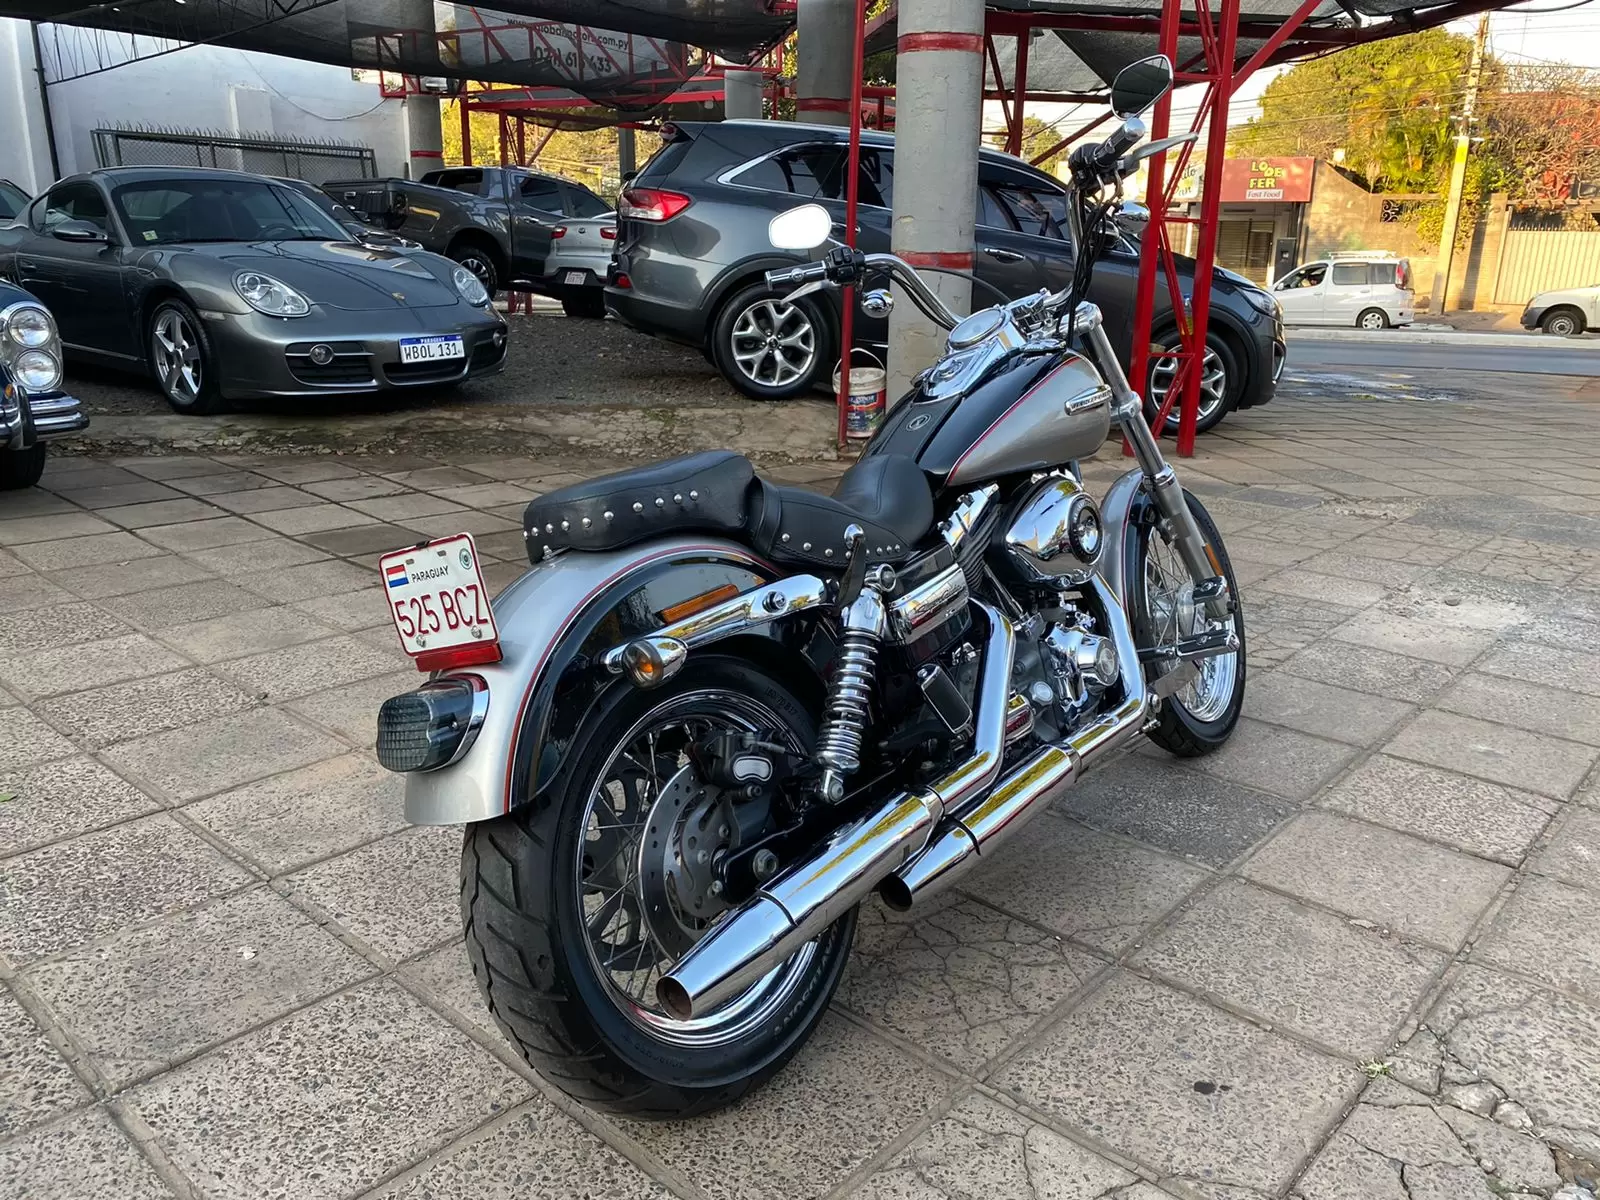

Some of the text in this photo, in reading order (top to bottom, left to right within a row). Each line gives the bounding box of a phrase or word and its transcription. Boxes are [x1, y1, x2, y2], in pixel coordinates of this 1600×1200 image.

[1249, 178, 1276, 188] FER
[404, 342, 458, 360] WBOL 131
[411, 565, 449, 582] PARAGUAY
[394, 584, 488, 638] 525 BCZ
